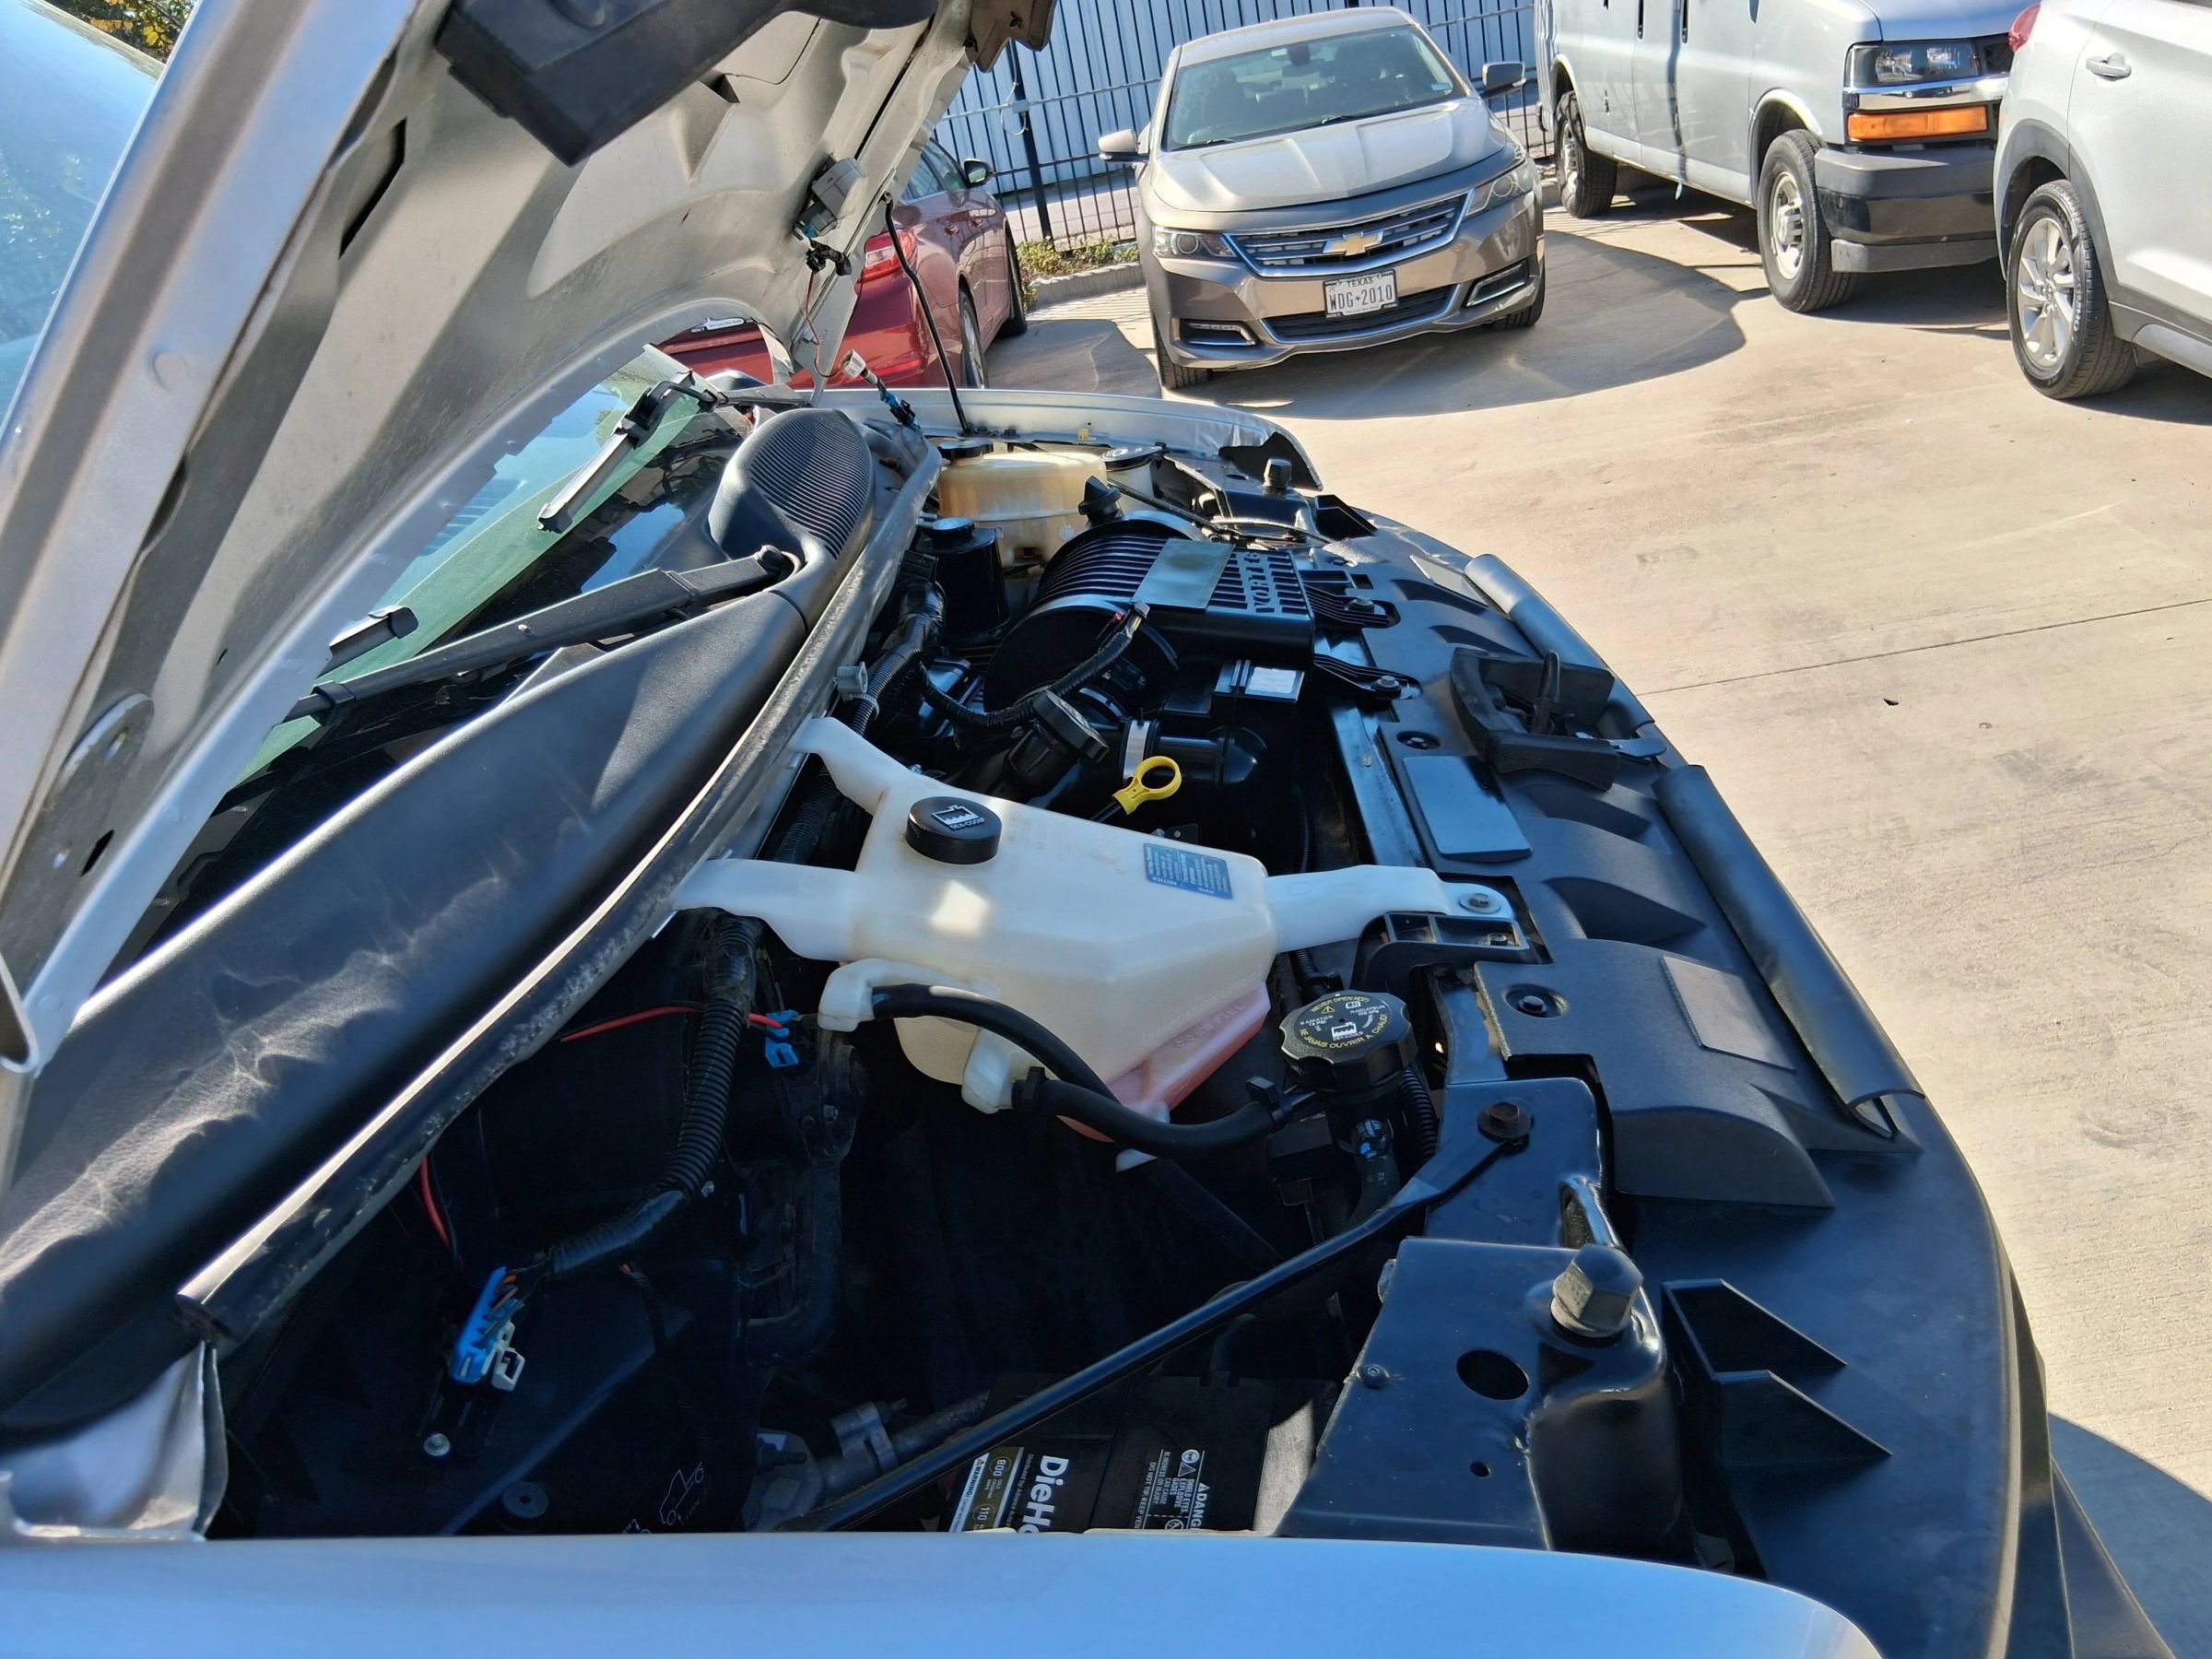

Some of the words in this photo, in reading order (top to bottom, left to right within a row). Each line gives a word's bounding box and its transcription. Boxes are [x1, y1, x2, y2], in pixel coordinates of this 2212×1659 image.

[1347, 276, 1373, 288] TEXAS
[1311, 1000, 1334, 1012] NEVER
[1329, 1037, 1365, 1048] OUVRIR
[993, 1459, 1006, 1477] 800
[1148, 1462, 1157, 1471] DO
[965, 1465, 982, 1498] WARNING:
[1145, 1472, 1154, 1485] NOT
[1170, 1477, 1180, 1495] GASES
[1174, 1477, 1187, 1508] EXPLOSIVE
[1184, 1478, 1194, 1497] SHIELD
[1159, 1488, 1170, 1504] CAUSE
[1138, 1497, 1148, 1514] KEEP
[1190, 1493, 1207, 1529] DANG
[977, 1507, 991, 1521] 110
